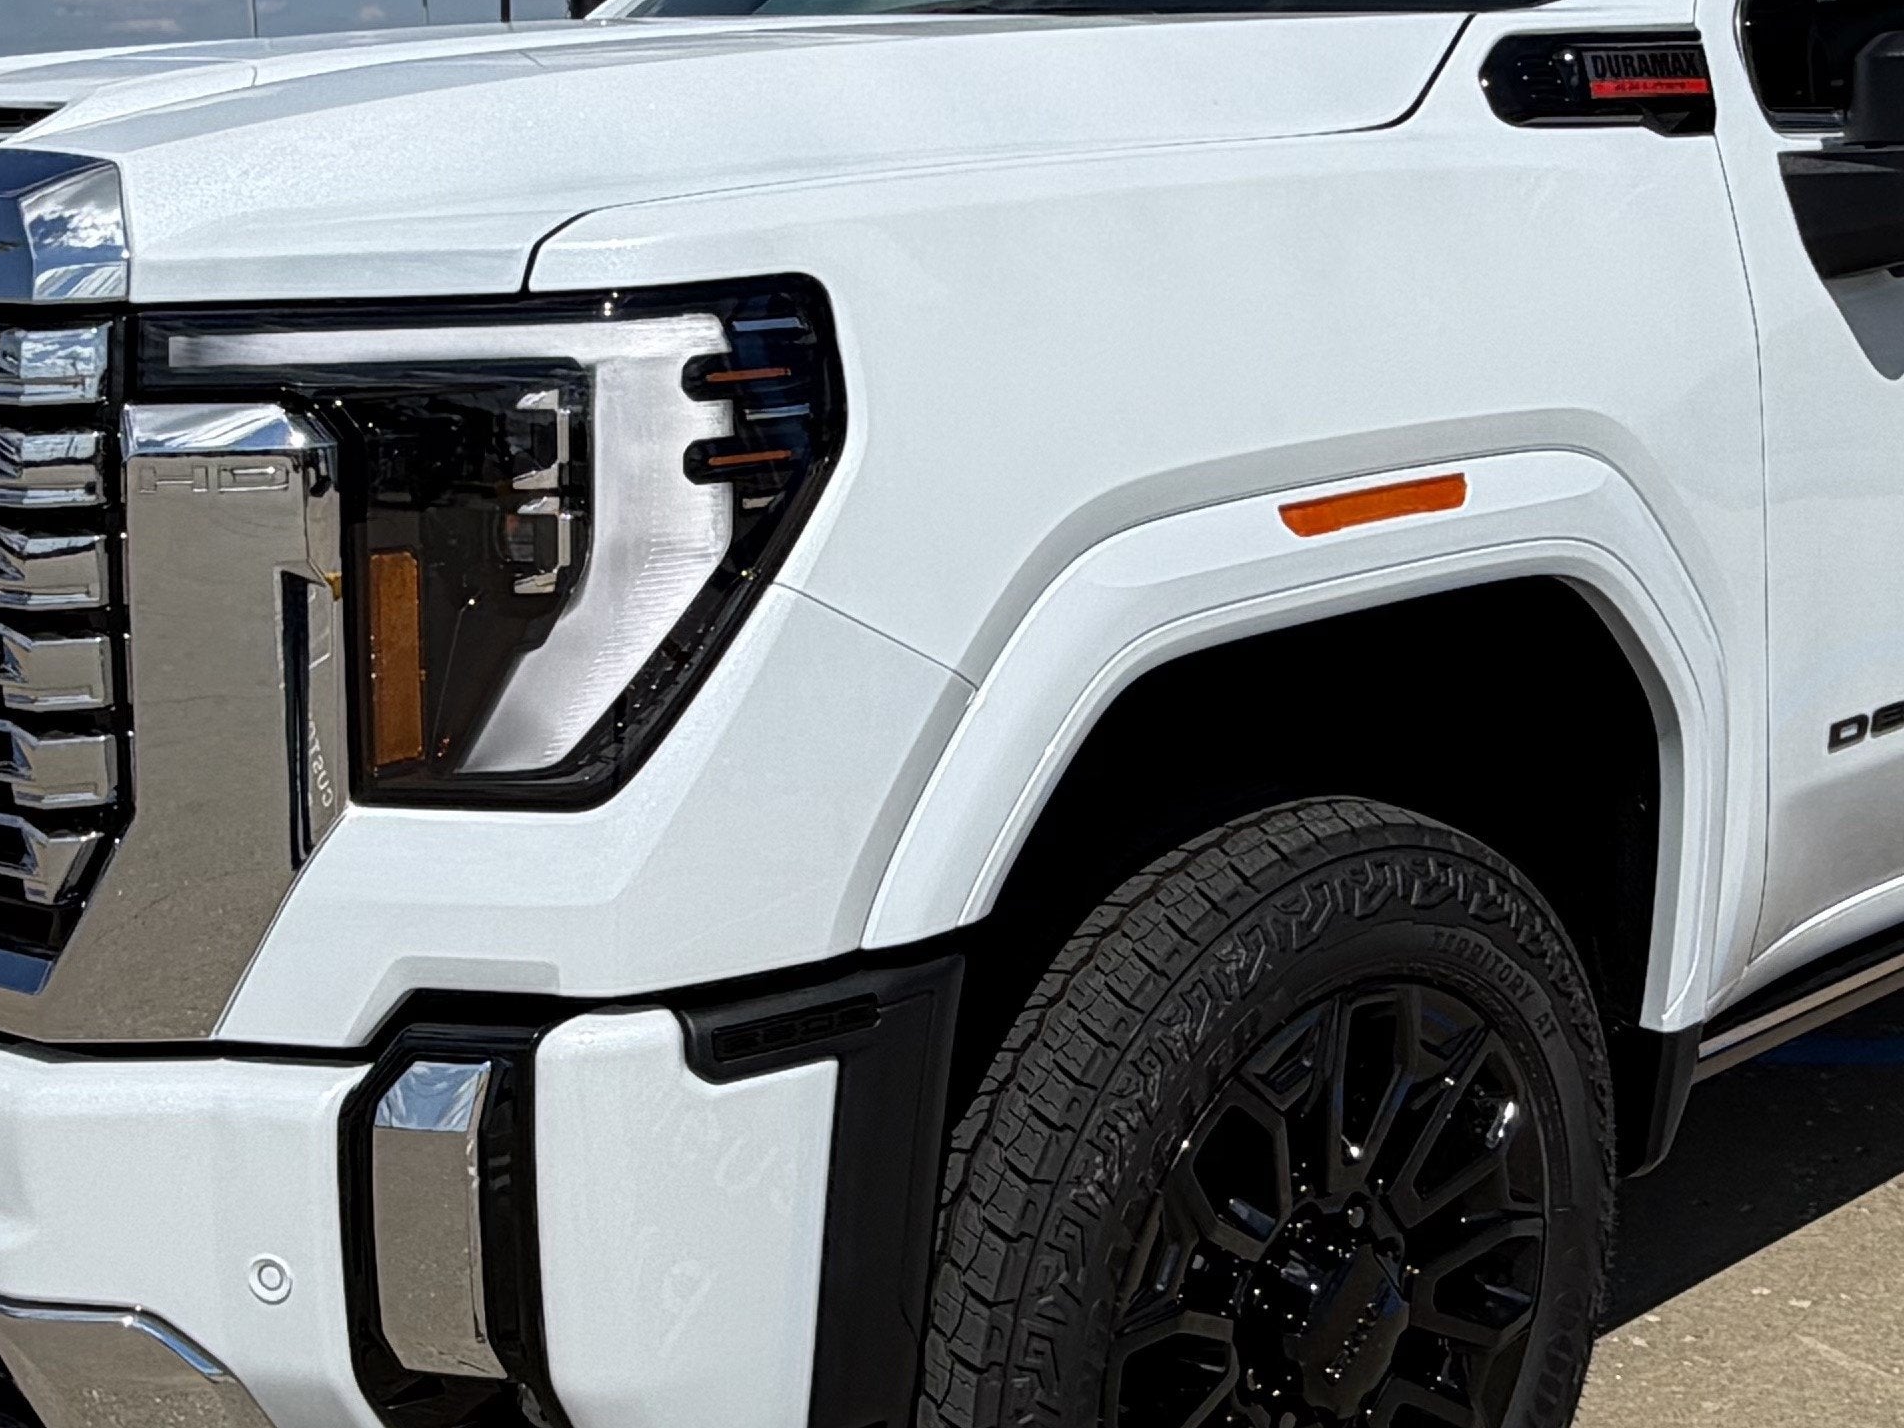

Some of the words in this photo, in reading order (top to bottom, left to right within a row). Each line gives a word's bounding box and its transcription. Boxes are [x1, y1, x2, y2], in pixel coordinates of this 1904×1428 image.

[1590, 52, 1698, 78] DURAMAX
[1434, 932, 1535, 1003] TERRITORY
[1535, 1012, 1558, 1038] AT
